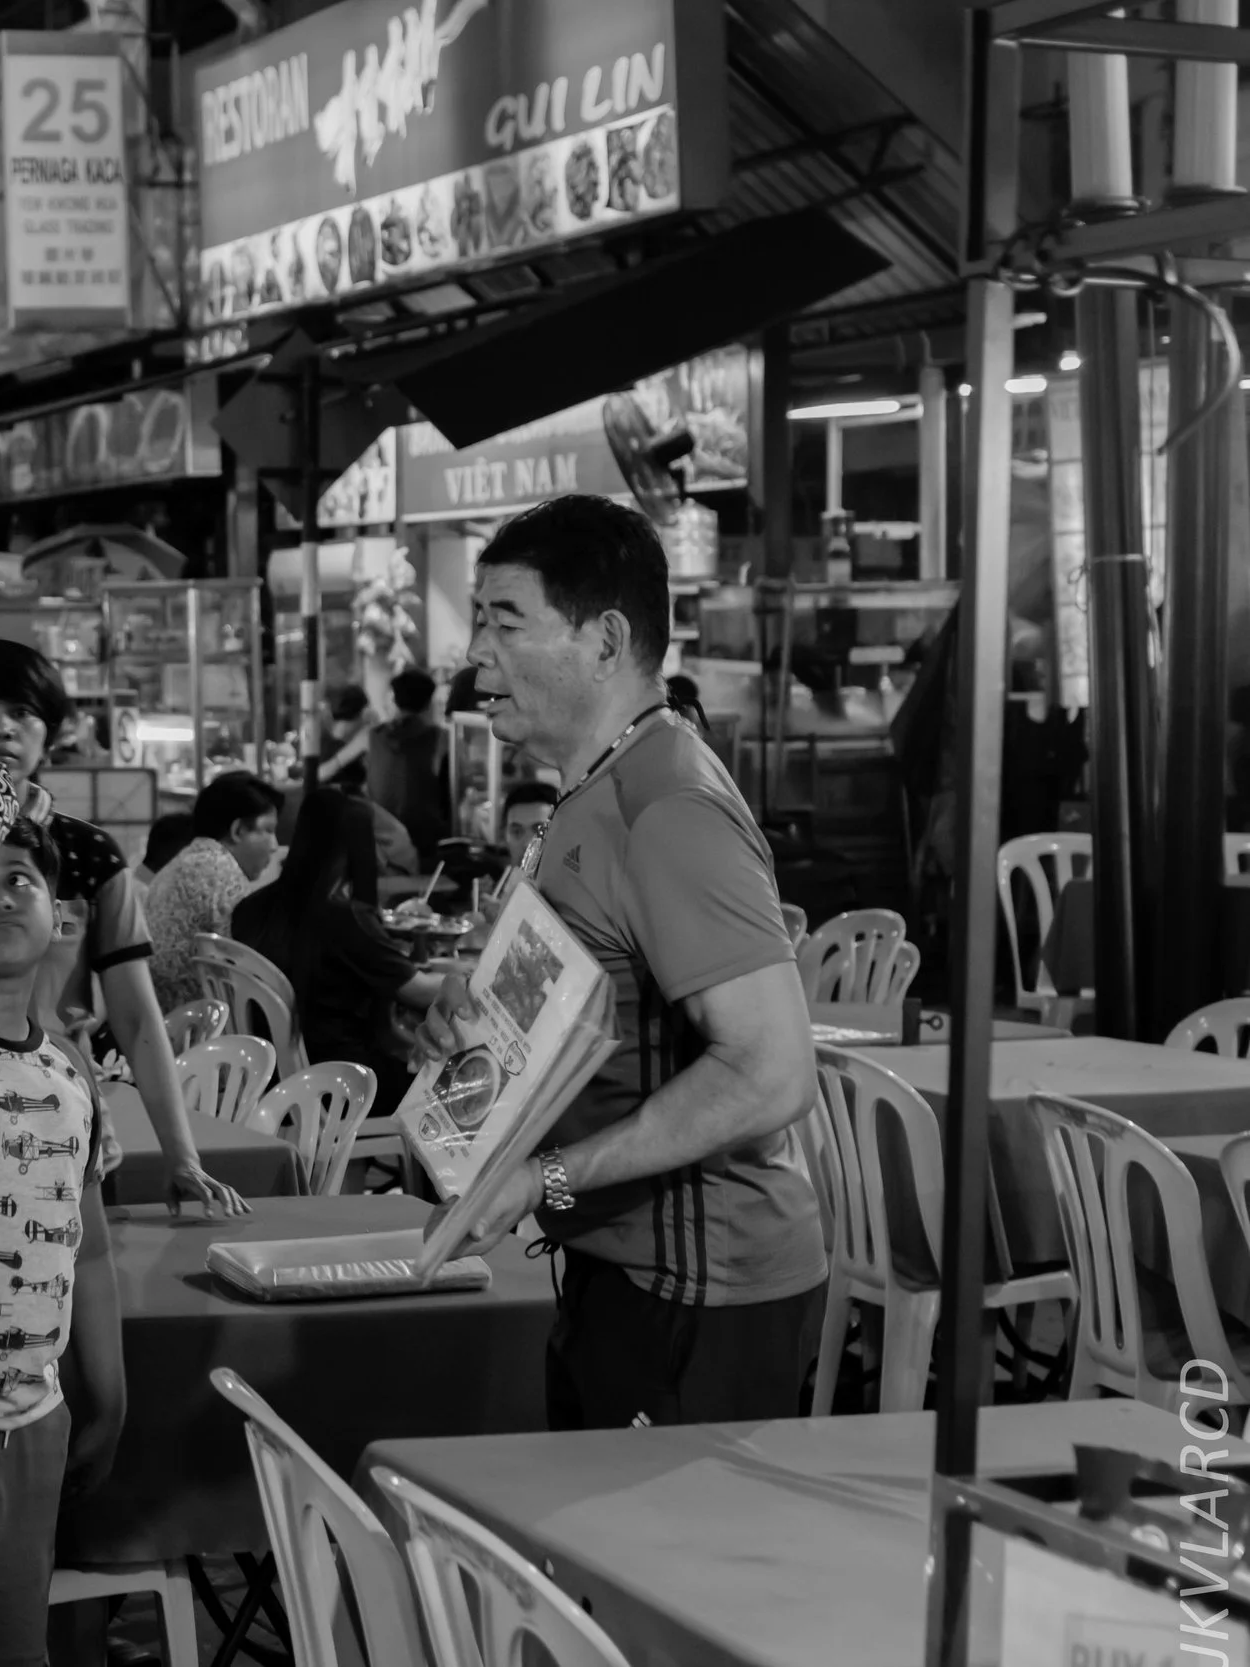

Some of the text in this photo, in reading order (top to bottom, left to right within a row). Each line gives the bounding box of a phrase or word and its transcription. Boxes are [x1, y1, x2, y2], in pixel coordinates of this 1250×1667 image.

[20, 77, 111, 144] 25
[202, 51, 309, 165] RESTORAN
[485, 42, 665, 150] GUI LIN
[513, 451, 578, 497] NAM
